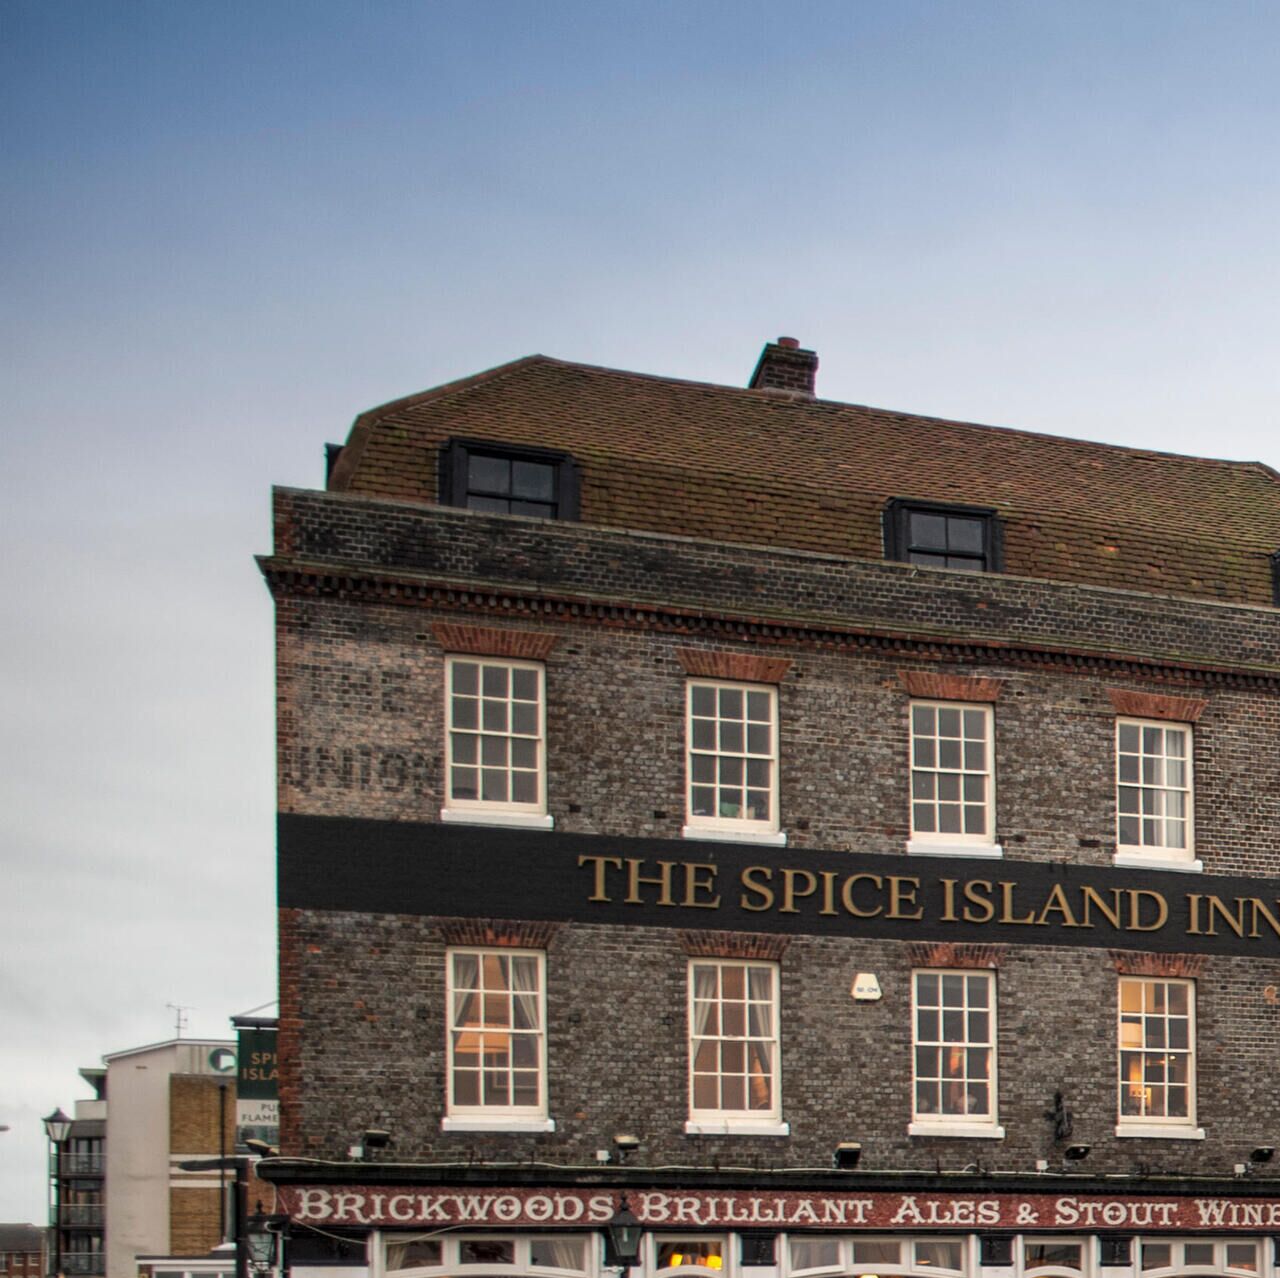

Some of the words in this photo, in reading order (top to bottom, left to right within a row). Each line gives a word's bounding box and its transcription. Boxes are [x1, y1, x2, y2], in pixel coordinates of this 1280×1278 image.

[578, 854, 721, 909] THE
[740, 865, 924, 921] SPICE
[939, 878, 1170, 933] ISLAND
[251, 1052, 278, 1065] SPI
[243, 1067, 279, 1080] ISLA
[261, 1103, 278, 1112] PU
[242, 1113, 278, 1122] FLAME
[295, 1188, 614, 1224] BRICKWOODS
[637, 1192, 874, 1225] BRILLIANT
[890, 1195, 1002, 1225] ALES
[1016, 1202, 1039, 1226] &
